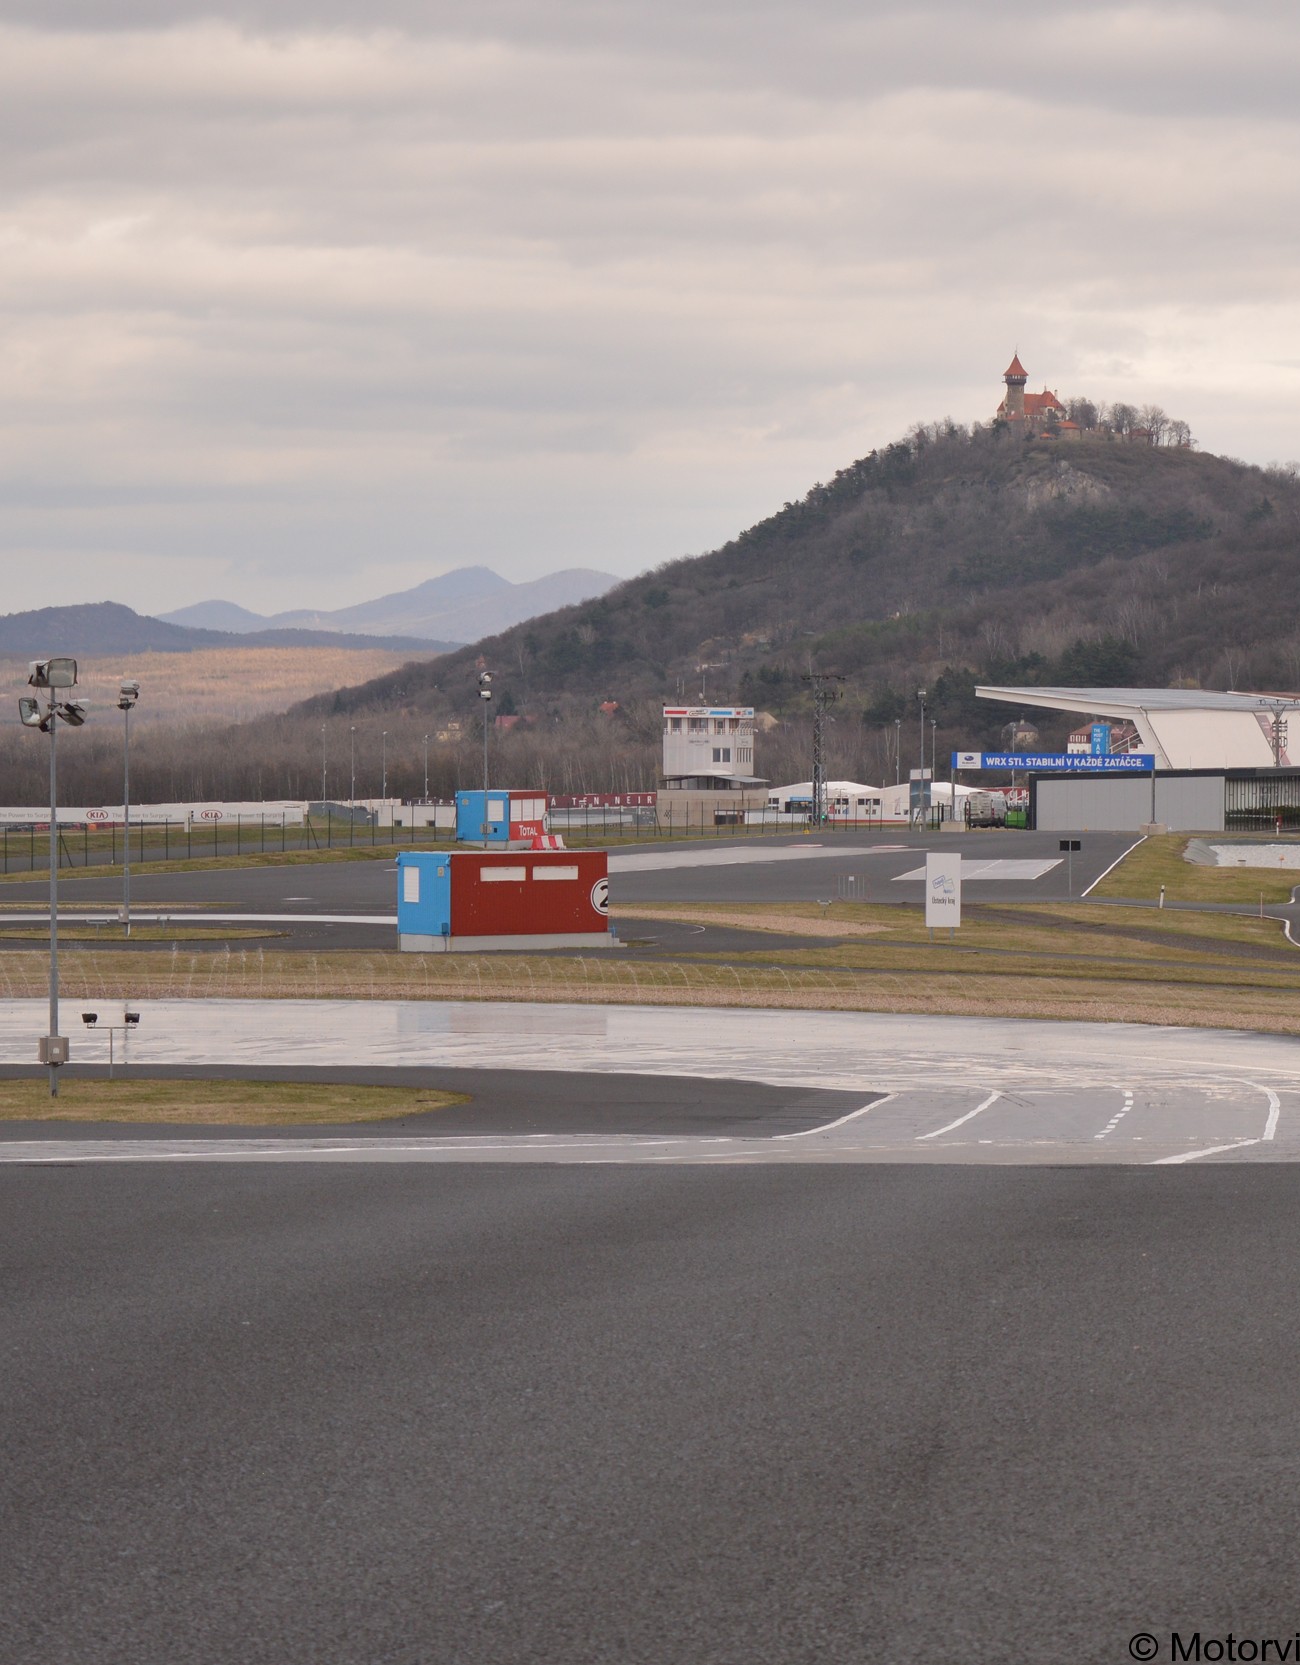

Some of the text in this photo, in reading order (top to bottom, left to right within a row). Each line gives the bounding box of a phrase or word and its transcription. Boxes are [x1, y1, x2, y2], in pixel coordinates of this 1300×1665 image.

[985, 755, 1145, 767] WRX STI. STABILNÍ V KAŽDÉ ZATÁČCE.
[89, 810, 105, 819] KIA
[204, 811, 219, 819] KIA
